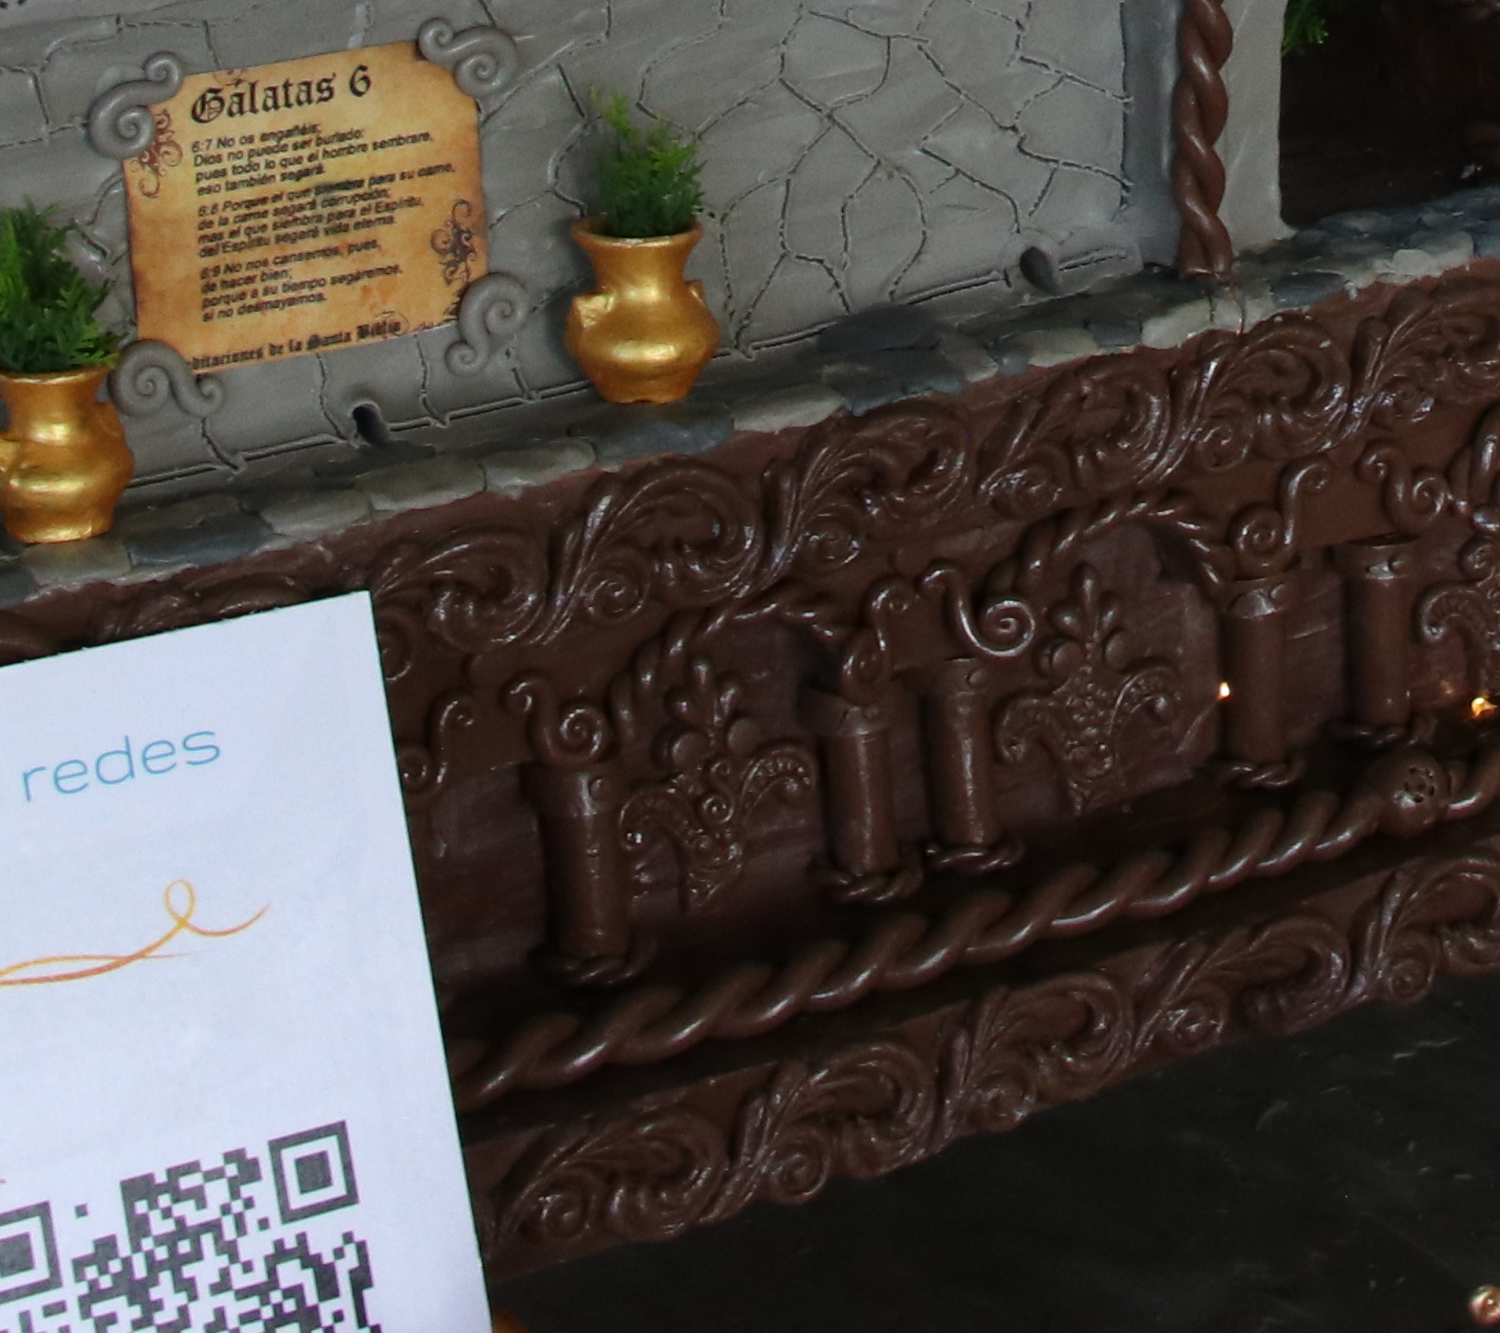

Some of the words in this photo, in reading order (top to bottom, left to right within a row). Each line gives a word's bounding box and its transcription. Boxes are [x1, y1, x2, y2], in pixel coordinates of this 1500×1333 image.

[191, 73, 336, 124] Gálatas
[349, 65, 371, 97] 6
[194, 155, 221, 166] Dios
[227, 151, 243, 160] no
[248, 142, 288, 159] puede
[292, 139, 312, 149] ser
[217, 137, 234, 148] No
[240, 135, 254, 144] os
[196, 169, 226, 183] pues
[232, 162, 259, 174] todo
[265, 158, 275, 169] lo
[280, 155, 303, 169] que
[322, 144, 368, 159] hombre
[197, 184, 220, 195] eso
[218, 309, 233, 318] no
[21, 727, 223, 806] redes
